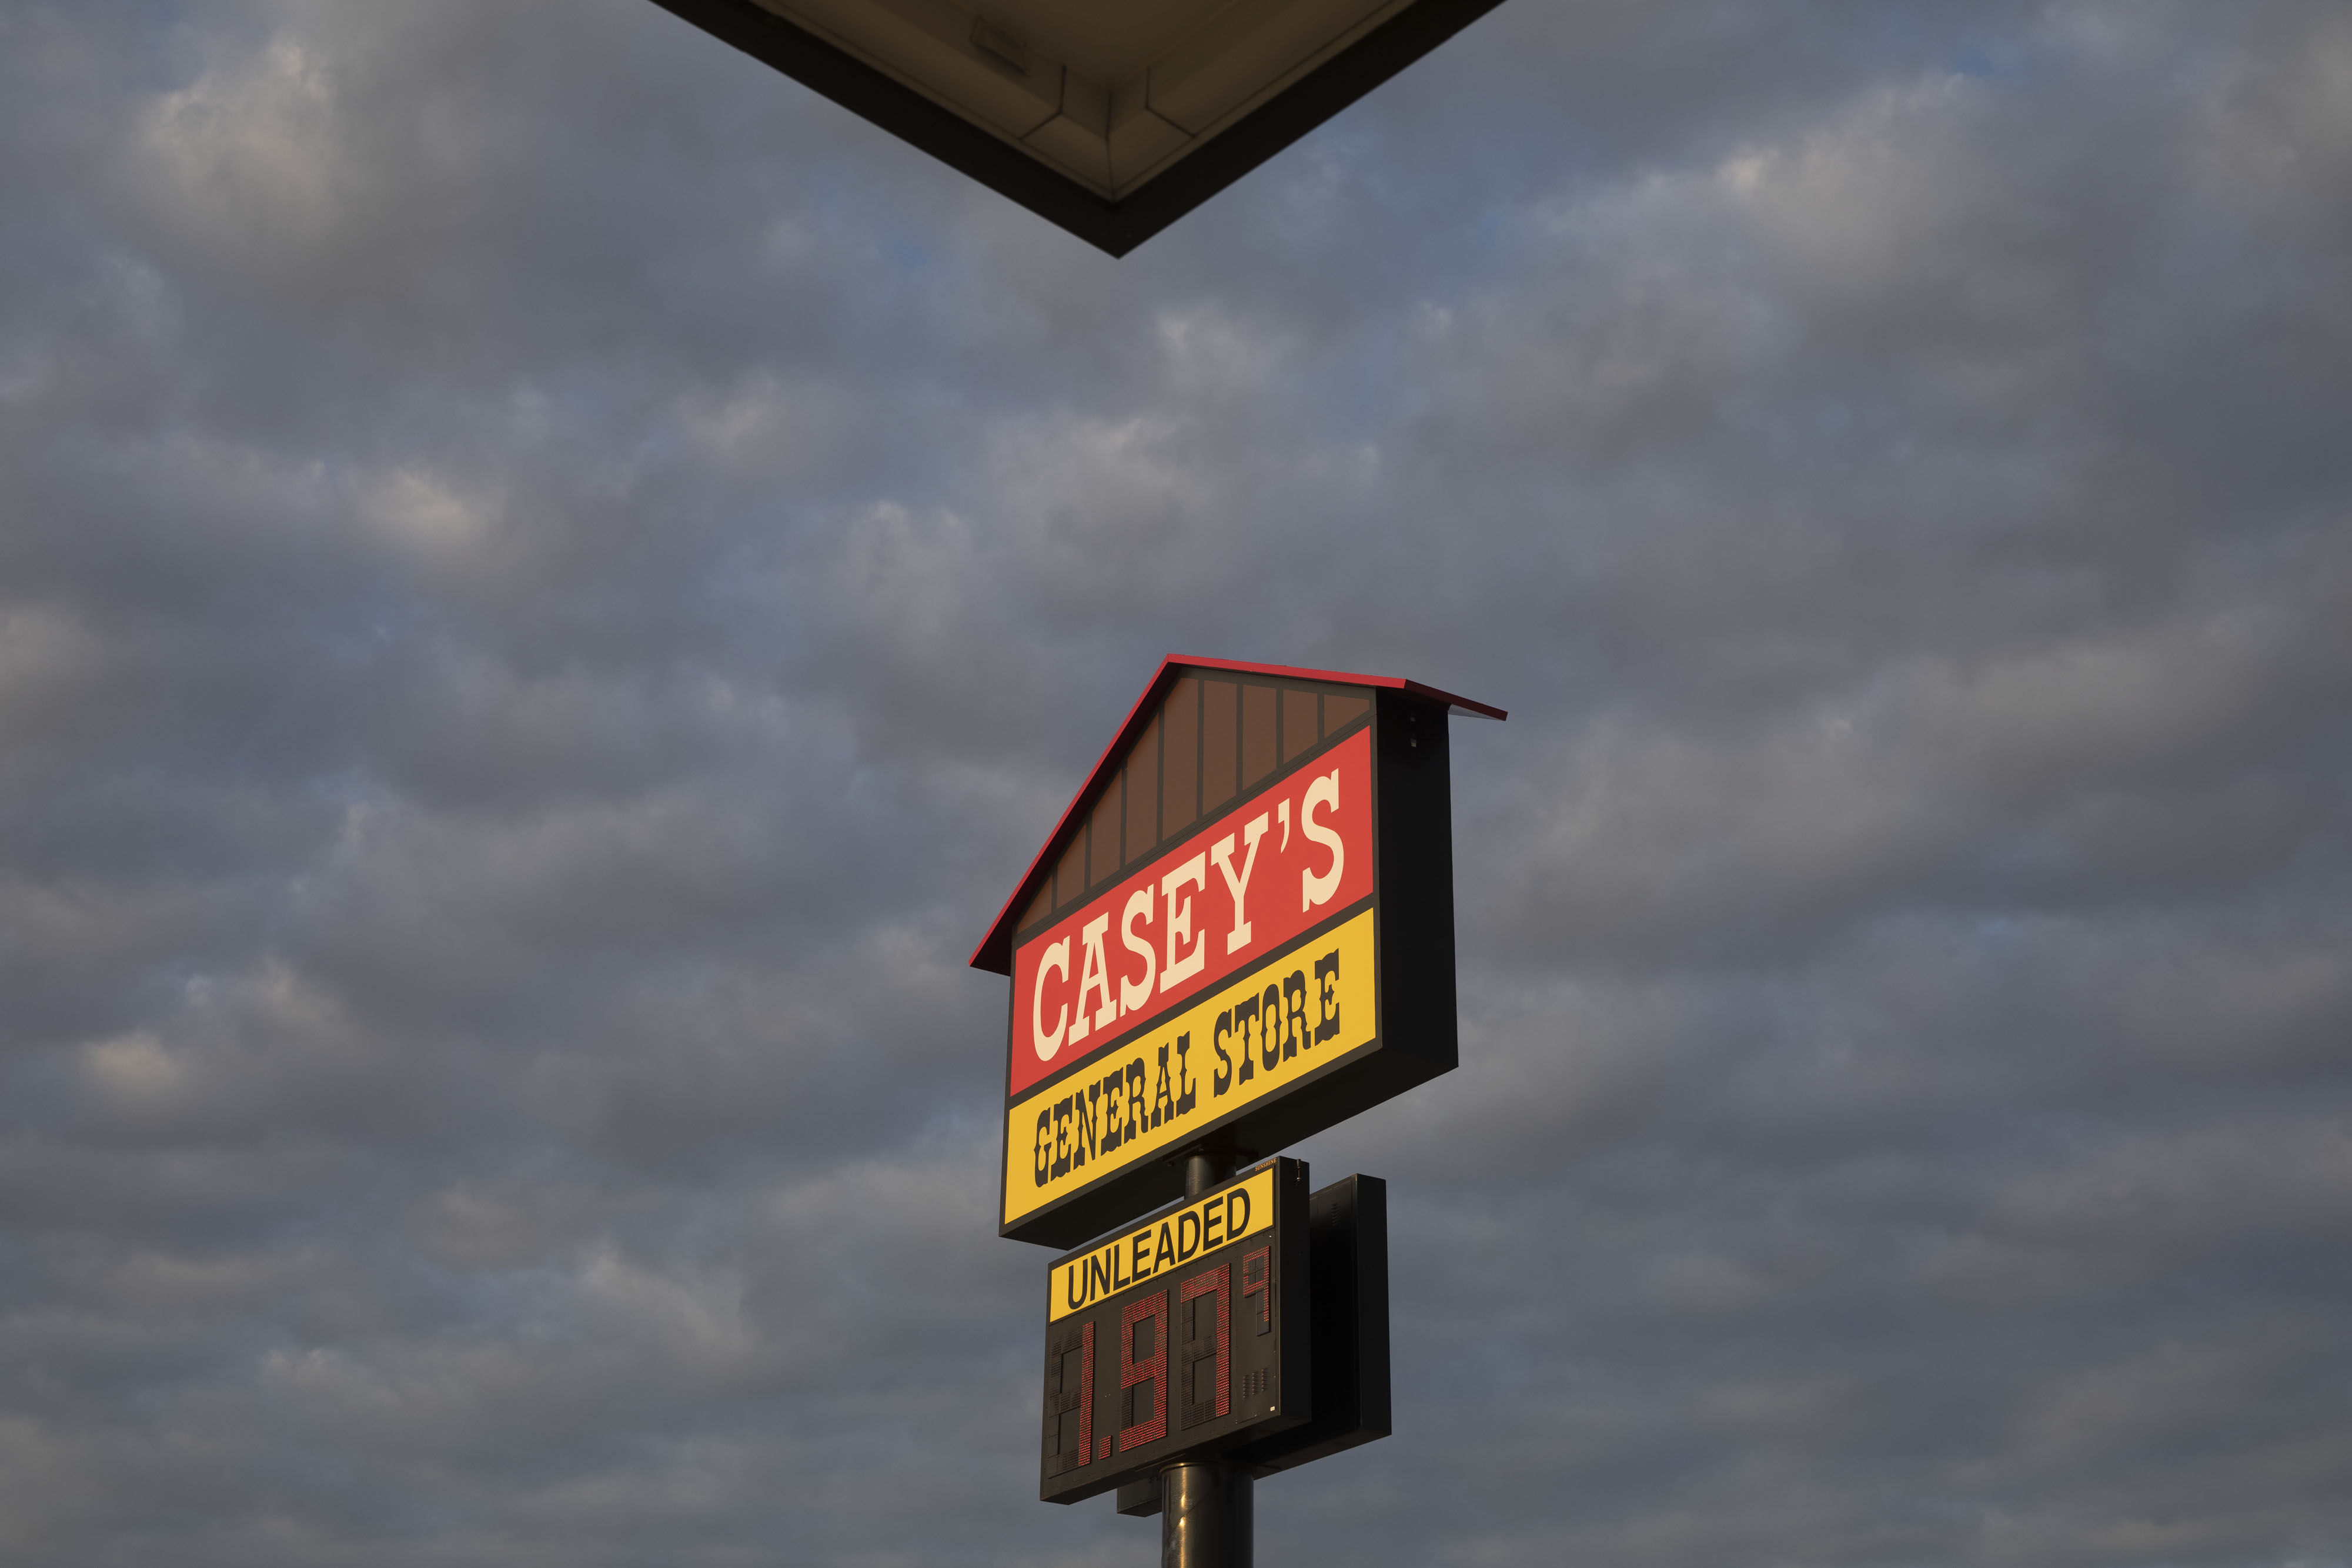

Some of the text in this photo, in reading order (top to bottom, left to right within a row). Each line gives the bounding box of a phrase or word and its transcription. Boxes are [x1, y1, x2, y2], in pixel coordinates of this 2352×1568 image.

[1033, 768, 1344, 1061] CASEY'S
[1033, 948, 1340, 1188] GENERAL STORE
[1067, 1188, 1251, 1310] UNLEADED
[1255, 1158, 1277, 1172] SUNSHINE
